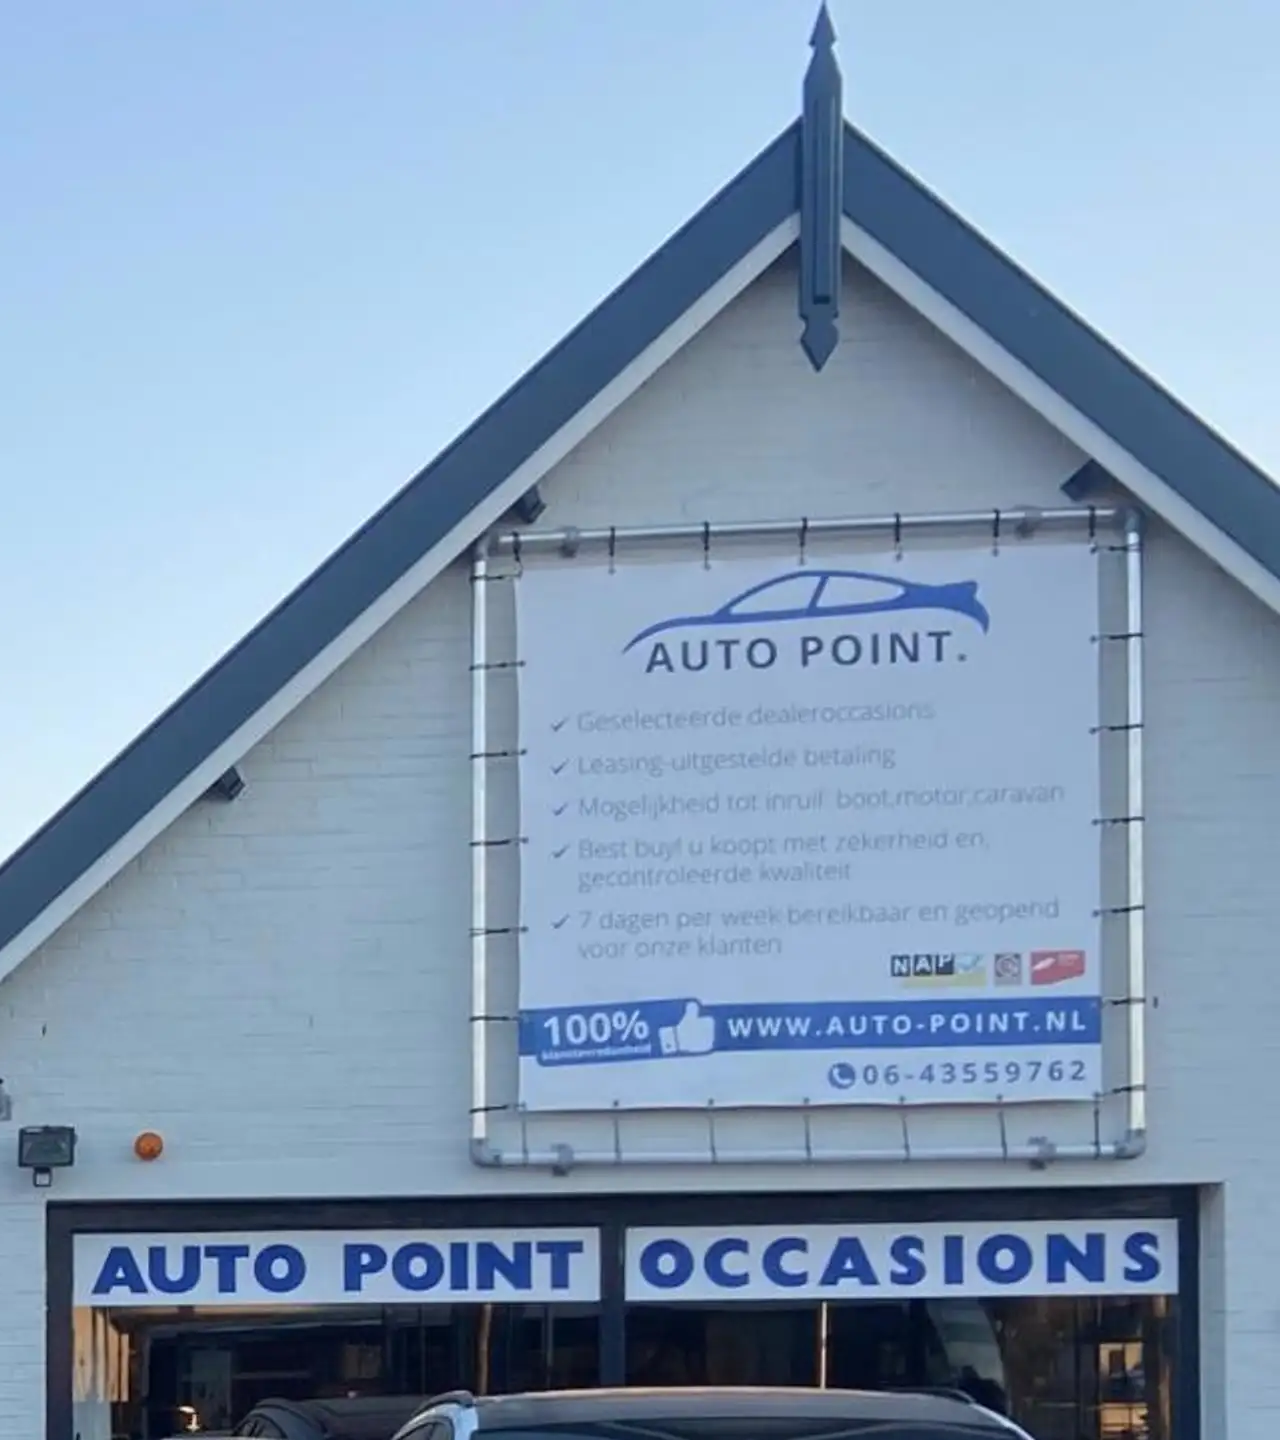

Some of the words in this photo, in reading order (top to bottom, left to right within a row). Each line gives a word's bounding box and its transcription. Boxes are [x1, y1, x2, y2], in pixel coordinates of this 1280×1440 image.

[645, 637, 777, 673] AUTO
[801, 631, 967, 667] POINT.
[577, 706, 742, 731] Geselecteerde
[746, 702, 936, 725] dealeroccasions
[578, 748, 796, 777] Leasing-uitgestelde
[803, 746, 896, 769] betaling
[578, 793, 719, 822] Mogelijkheid
[727, 795, 757, 812] tot
[765, 791, 822, 812] inruil
[578, 838, 627, 860] Best
[689, 841, 702, 856] u
[710, 835, 775, 860] koopt
[784, 834, 826, 854] met
[835, 831, 948, 853] zekerheid
[578, 864, 752, 893] gecontroleerde
[760, 861, 851, 883] kwaliteit
[579, 910, 592, 929] 7
[598, 911, 669, 934] dagen
[676, 909, 712, 932] per
[721, 905, 780, 927] week
[787, 902, 910, 925] bereikbaar
[918, 904, 948, 922] en
[954, 897, 1060, 926] geopend
[578, 941, 627, 959] voor
[634, 939, 689, 958] onze
[698, 934, 782, 957] klanten
[891, 953, 955, 976] NAP
[543, 1009, 649, 1046] 100%
[727, 1010, 1086, 1037] WWW.AUTO-POINT.NL
[863, 1060, 1086, 1085] 06-43559762
[91, 1243, 307, 1294] AUTO
[343, 1241, 584, 1291] POINT
[639, 1231, 1161, 1289] OCCASIONS
